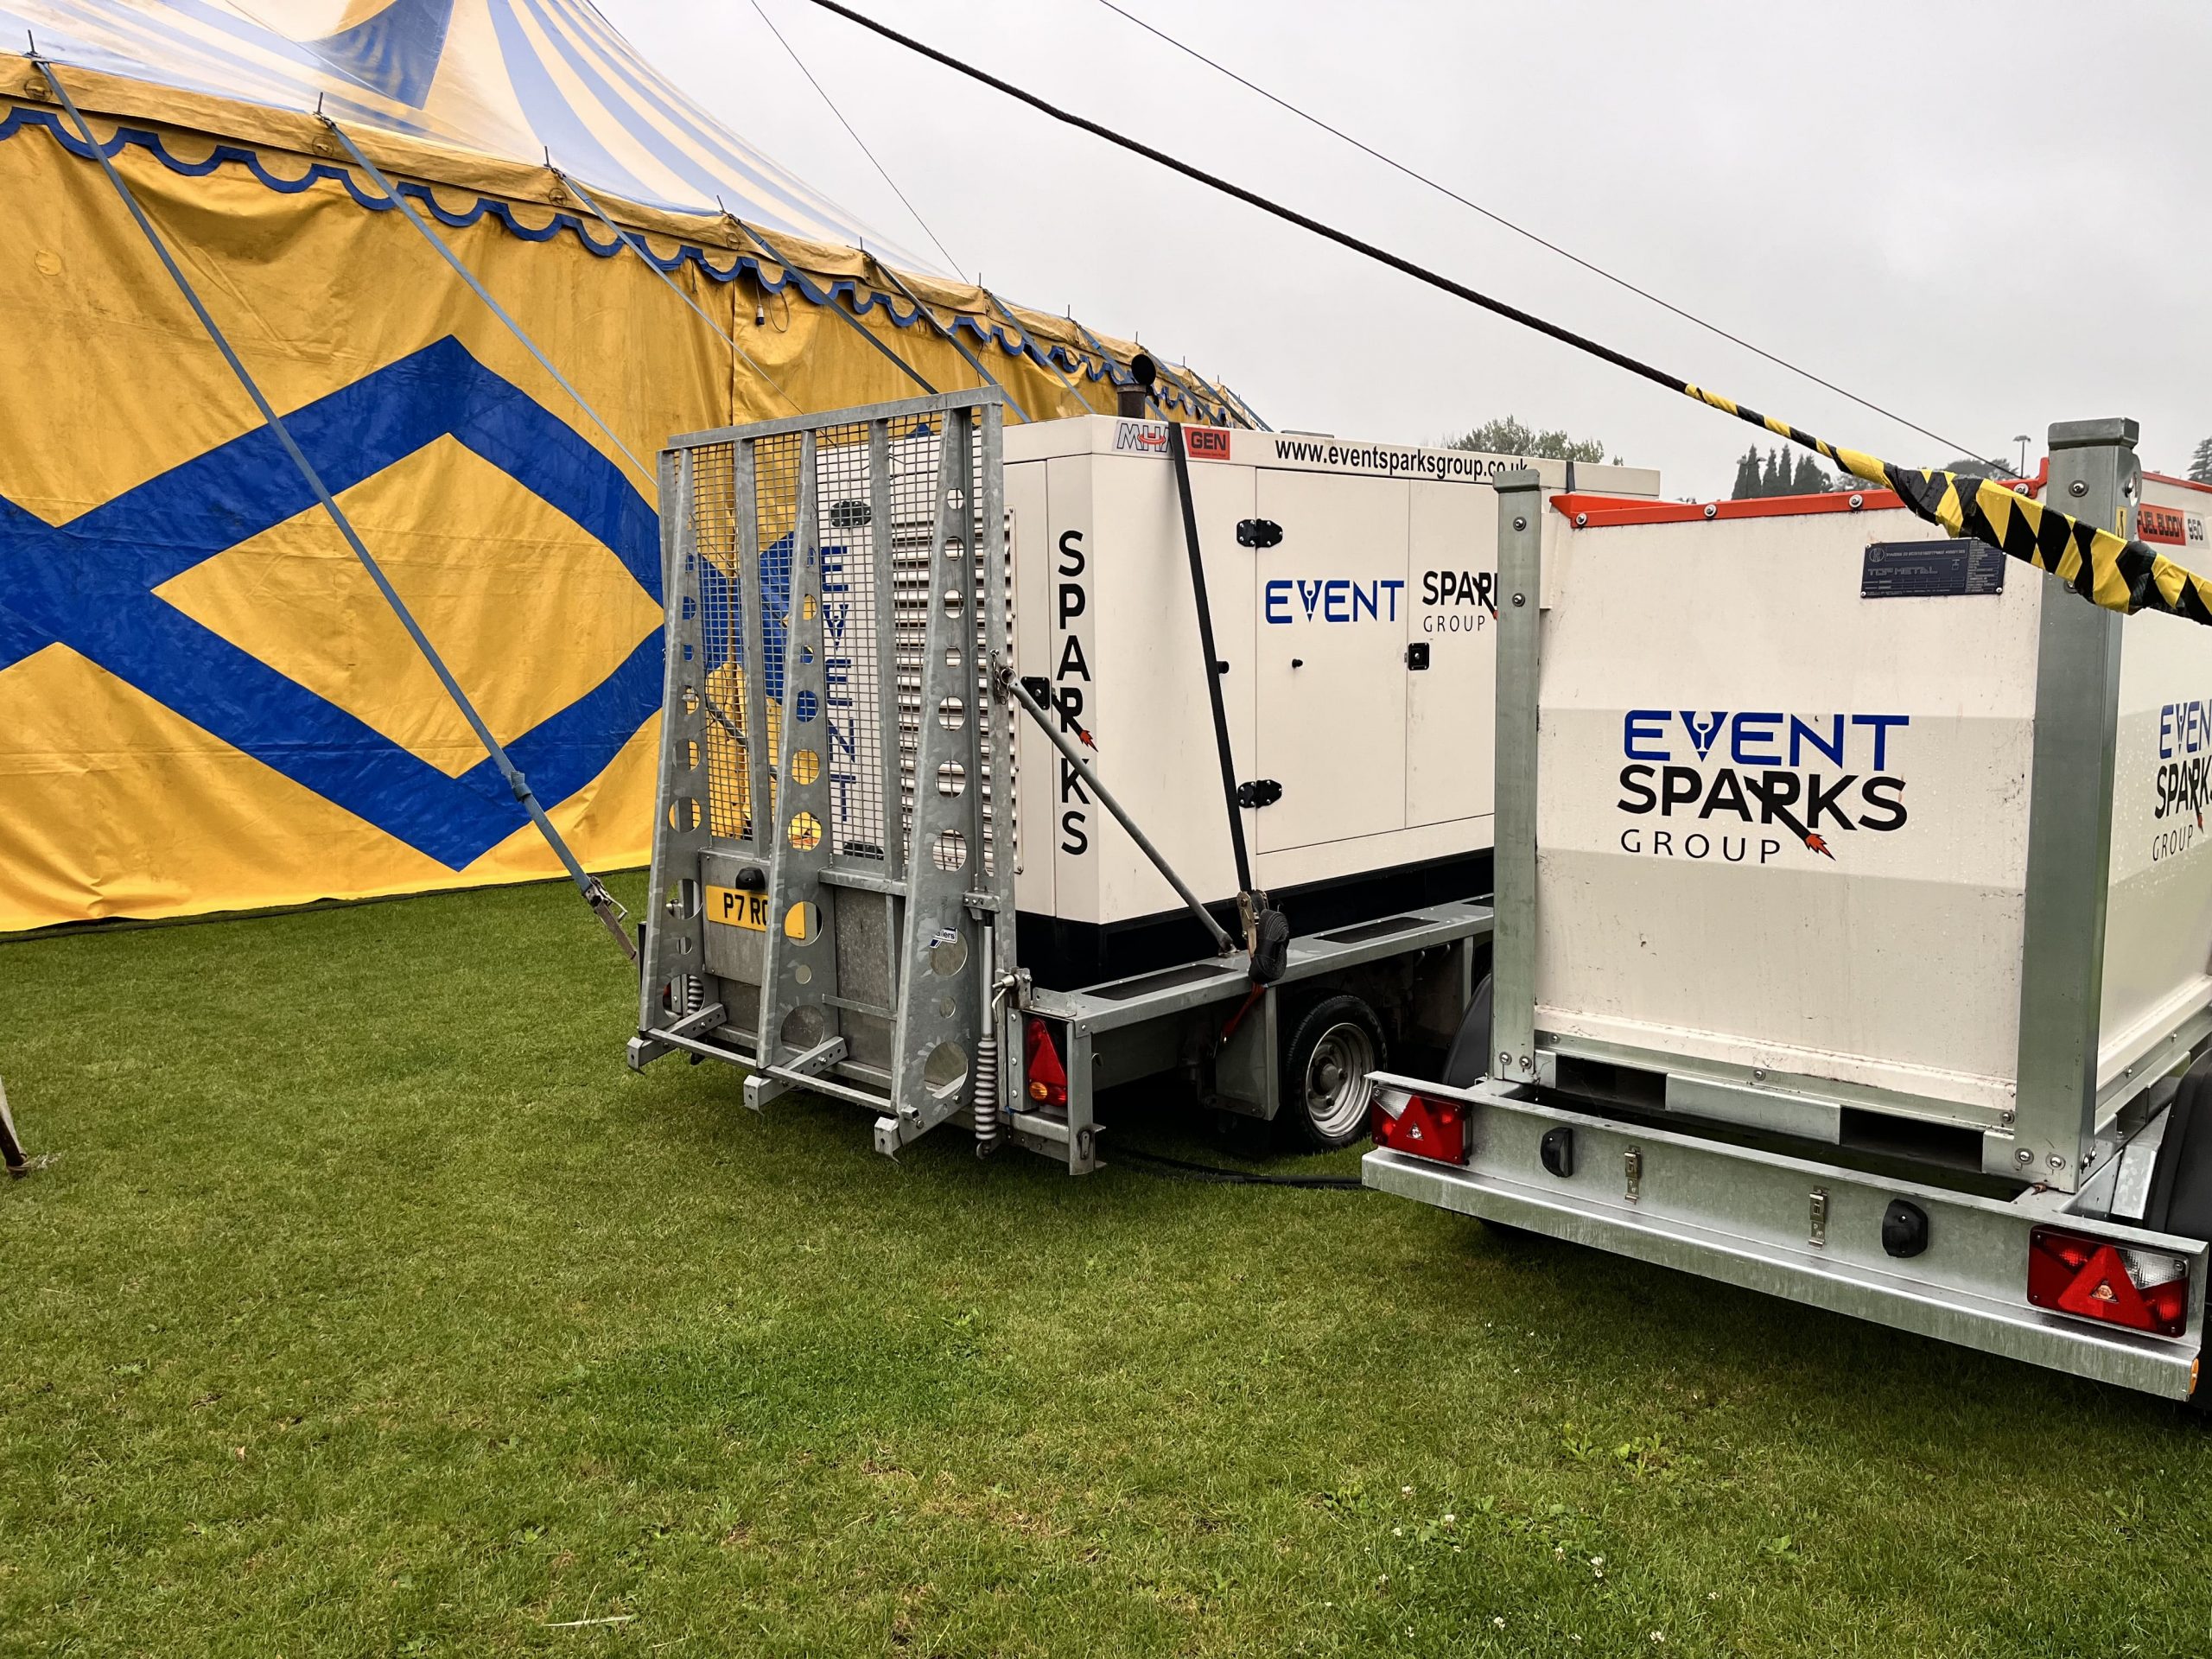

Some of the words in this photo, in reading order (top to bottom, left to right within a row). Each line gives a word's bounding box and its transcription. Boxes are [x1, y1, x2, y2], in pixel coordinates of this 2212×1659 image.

[1191, 431, 1226, 451] GEN
[2187, 518, 2203, 541] 950
[1265, 580, 1404, 624] EVENT
[1422, 570, 1497, 615] SPAR
[1423, 614, 1485, 632] GROUP
[821, 546, 856, 822] EVENT
[1056, 530, 1090, 855] SPARKS
[1624, 709, 1909, 771] EVENT
[2160, 698, 2212, 759] EVEN
[1617, 764, 1908, 840] SPARKS
[2155, 755, 2212, 819] SPARK
[1621, 829, 1780, 863] GROUP
[2152, 824, 2194, 861] GROUP
[723, 893, 744, 921] P7
